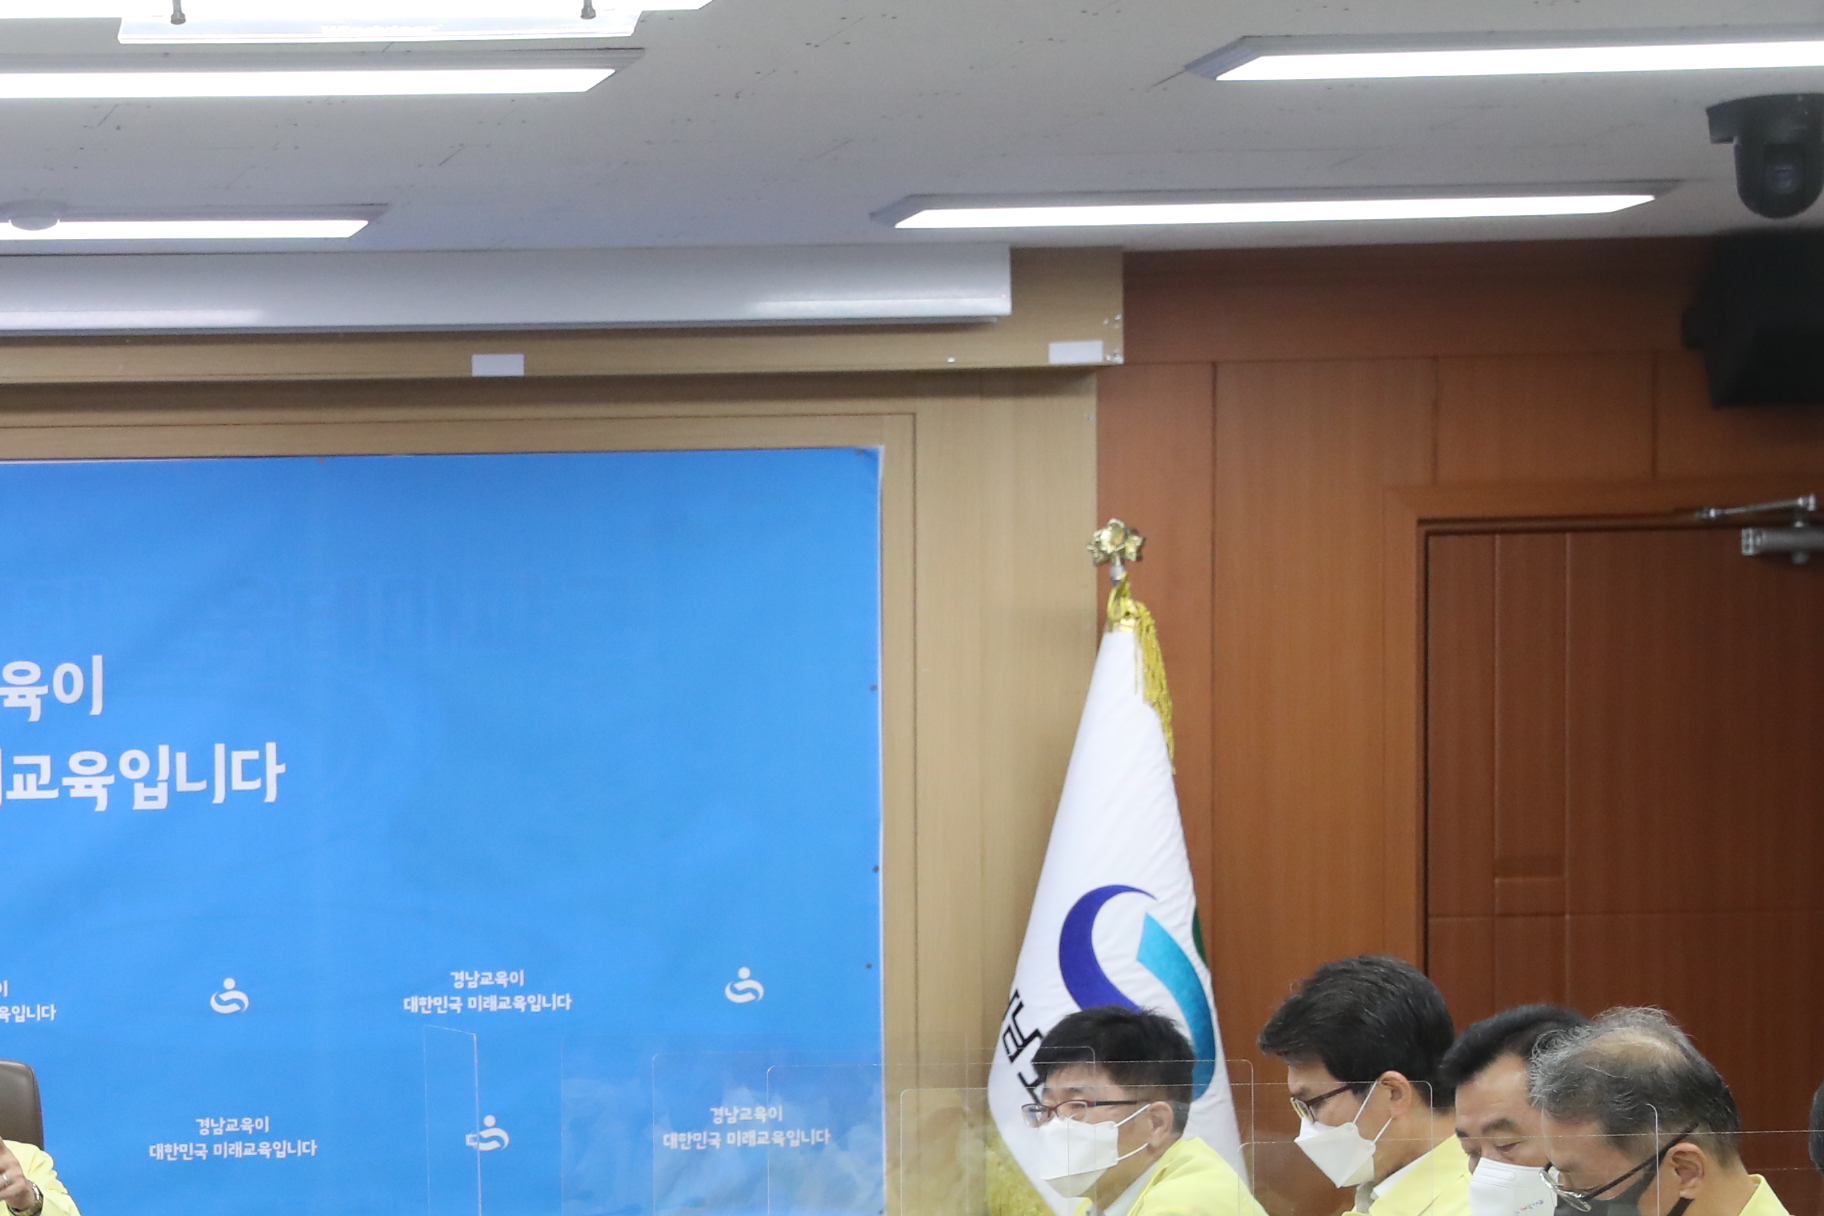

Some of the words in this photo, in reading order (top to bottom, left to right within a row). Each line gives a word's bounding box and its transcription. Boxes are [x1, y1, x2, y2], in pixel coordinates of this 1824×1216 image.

[450, 969, 525, 990] 경남교육이
[403, 995, 463, 1015] 대한민국
[467, 993, 573, 1013] 미래교육입니다
[195, 1115, 270, 1136] 경남교육이
[710, 1105, 783, 1125] 경남교육이
[662, 1131, 722, 1151] 대한민국
[726, 1128, 832, 1148] 미래교육입니다
[149, 1142, 209, 1162] 대한민국
[213, 1139, 318, 1159] 미래교육입니다
